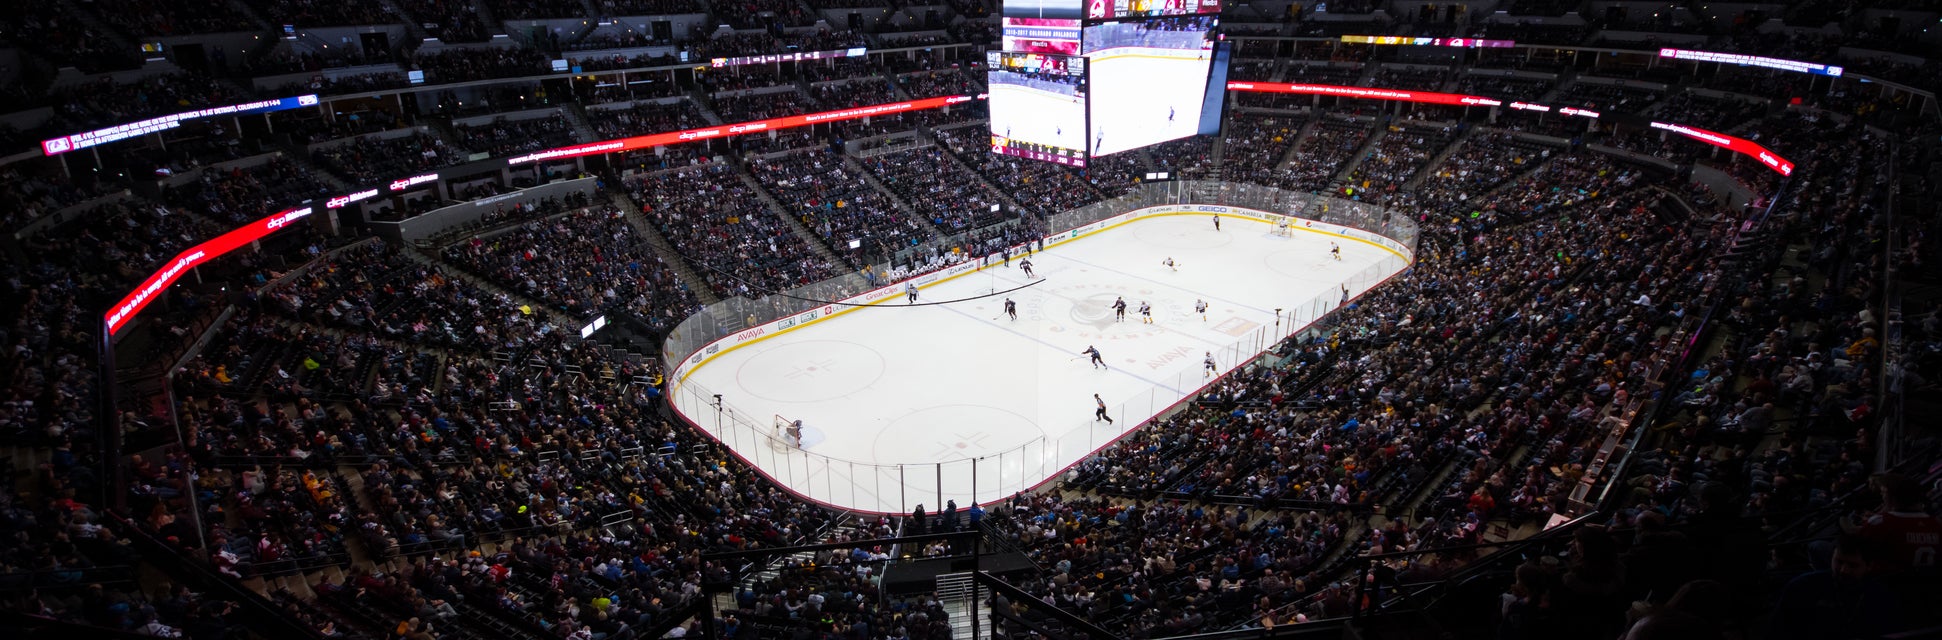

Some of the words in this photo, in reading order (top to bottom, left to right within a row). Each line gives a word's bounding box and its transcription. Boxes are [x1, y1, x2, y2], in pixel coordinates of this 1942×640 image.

[390, 179, 409, 190] dcp
[327, 196, 349, 208] dcp
[267, 218, 285, 229] dcp
[866, 290, 884, 300] Great
[884, 286, 899, 297] Clips
[737, 328, 764, 342] AVAYA
[1146, 346, 1195, 370] AVAYA
